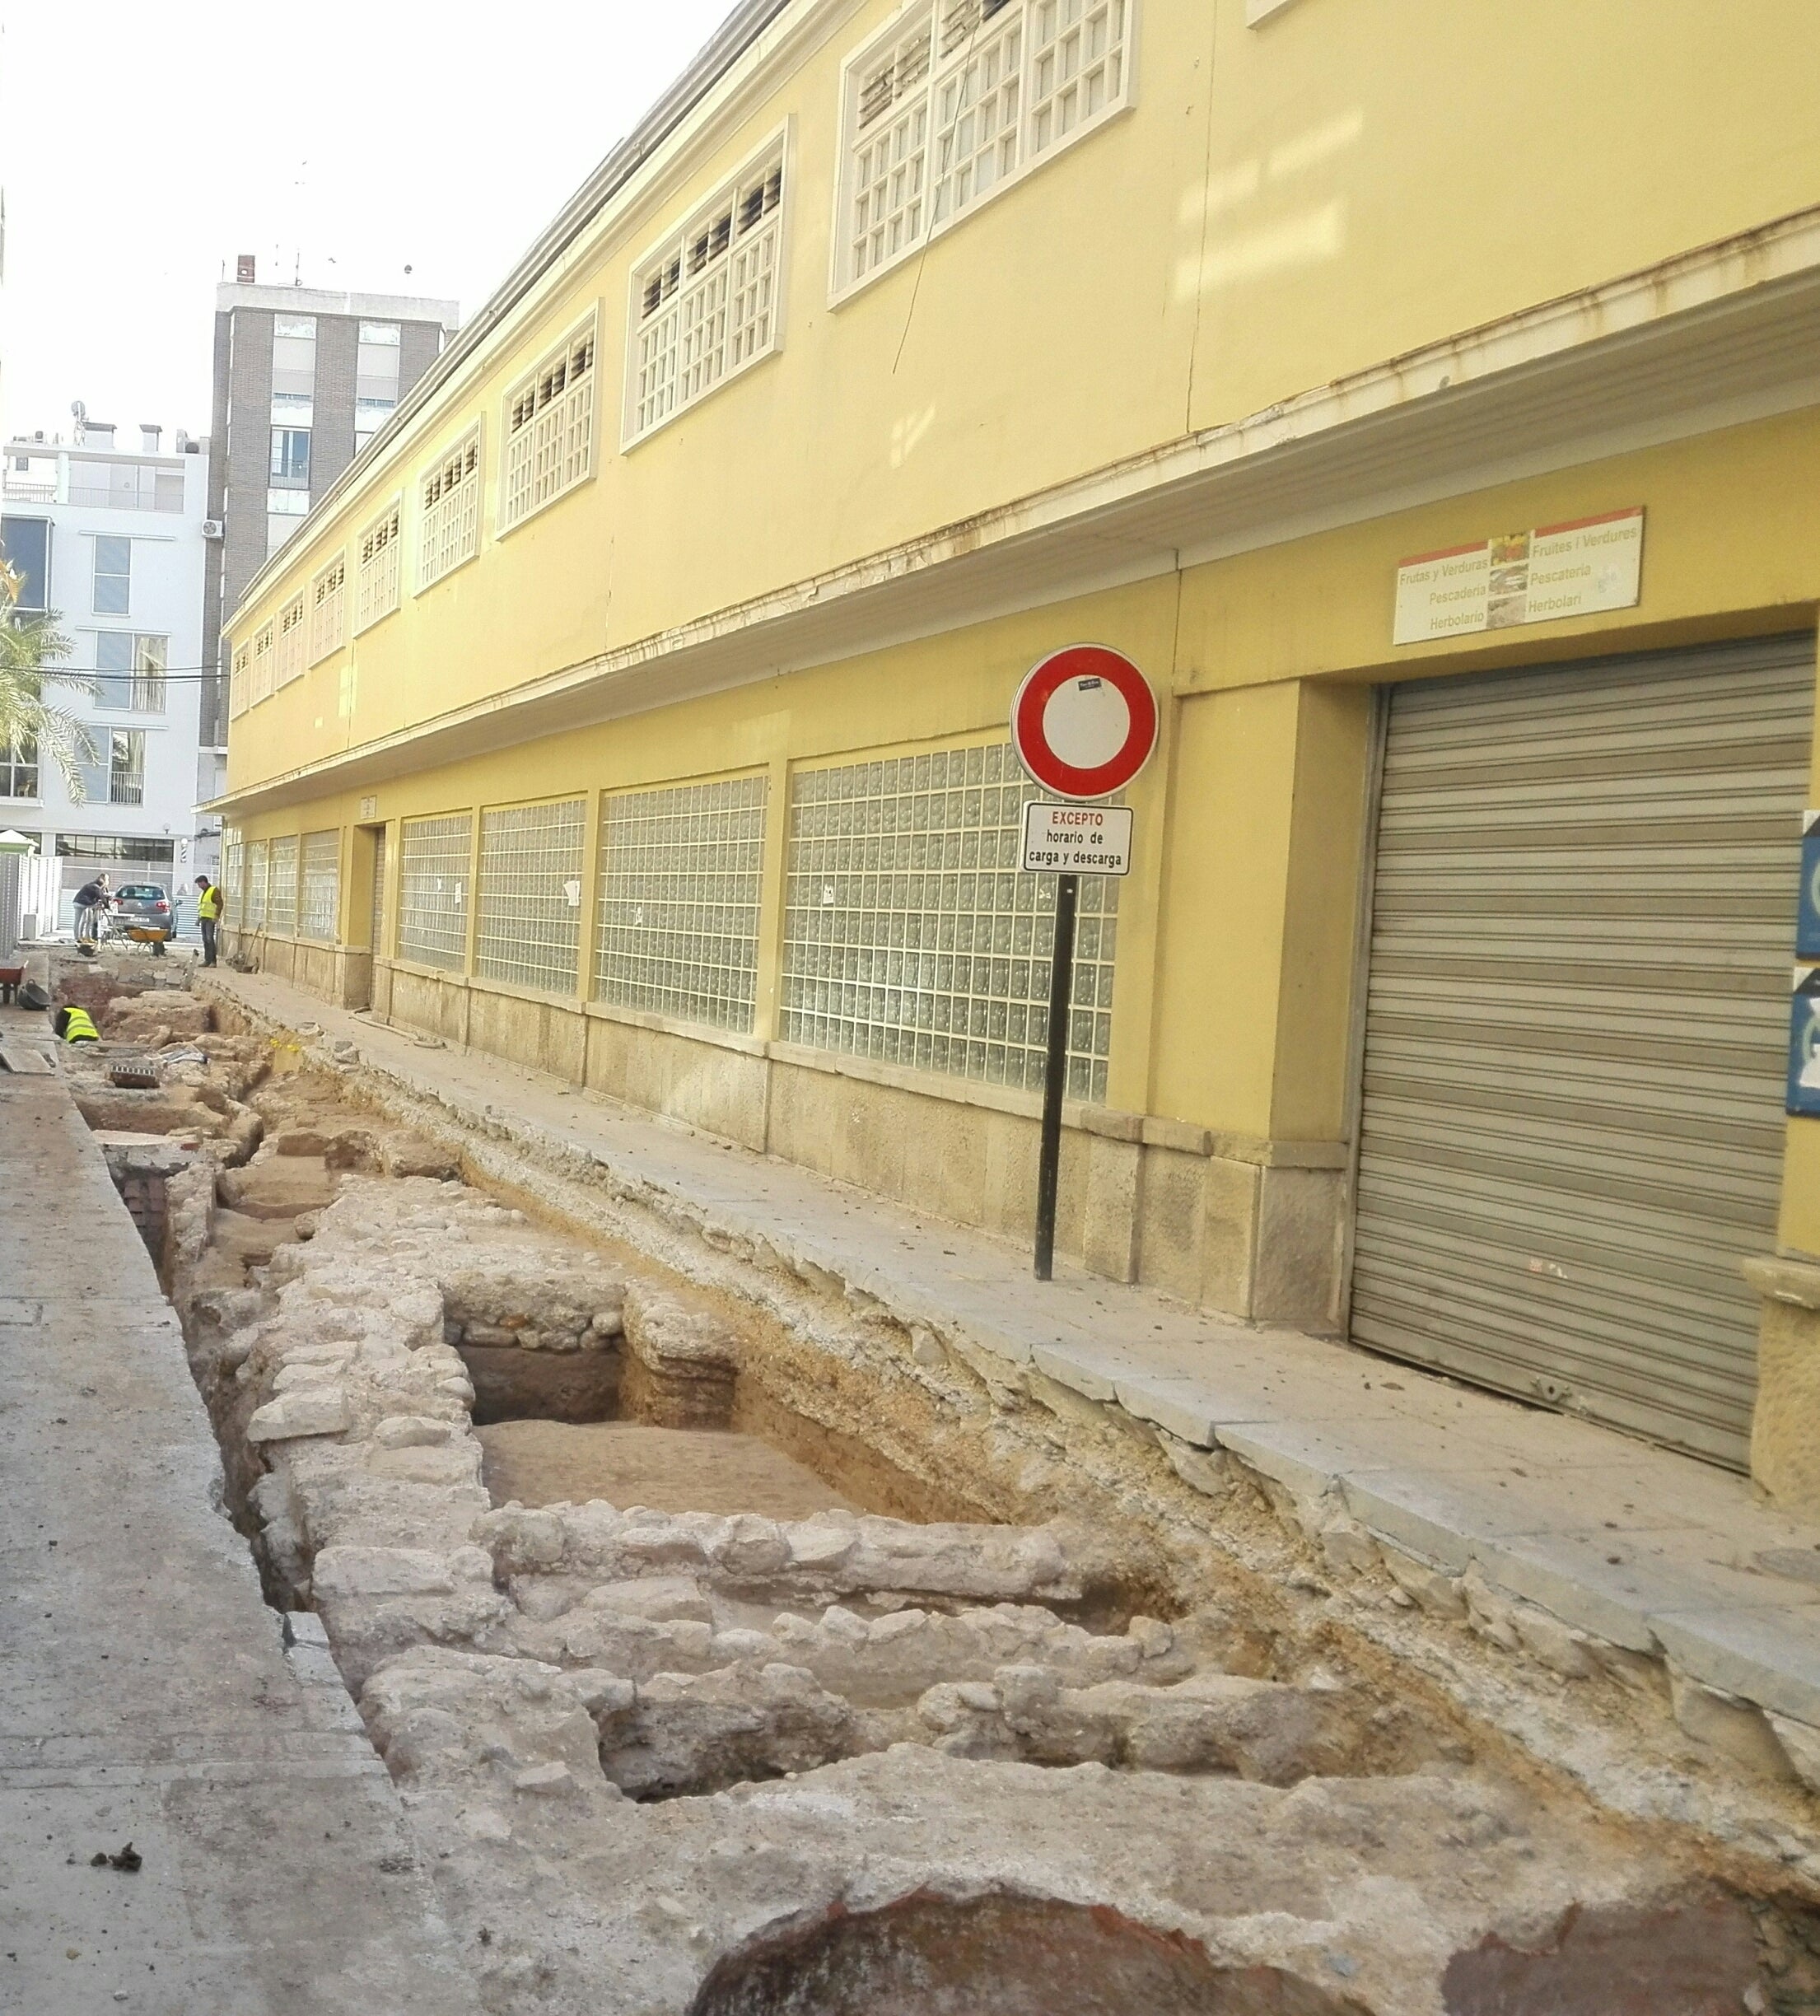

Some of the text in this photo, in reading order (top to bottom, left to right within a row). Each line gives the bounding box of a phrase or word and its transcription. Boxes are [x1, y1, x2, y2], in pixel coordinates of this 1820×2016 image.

[1533, 541, 1572, 557] Fruites
[1583, 527, 1637, 548] Verdures
[1400, 559, 1488, 585] Frutas y Verduras
[1528, 593, 1581, 613] Herbolari
[1430, 610, 1484, 630] Herbolario
[1052, 811, 1104, 826] EXCEPTO
[1047, 828, 1104, 845] horario de
[1029, 851, 1122, 869] carga y descarga
